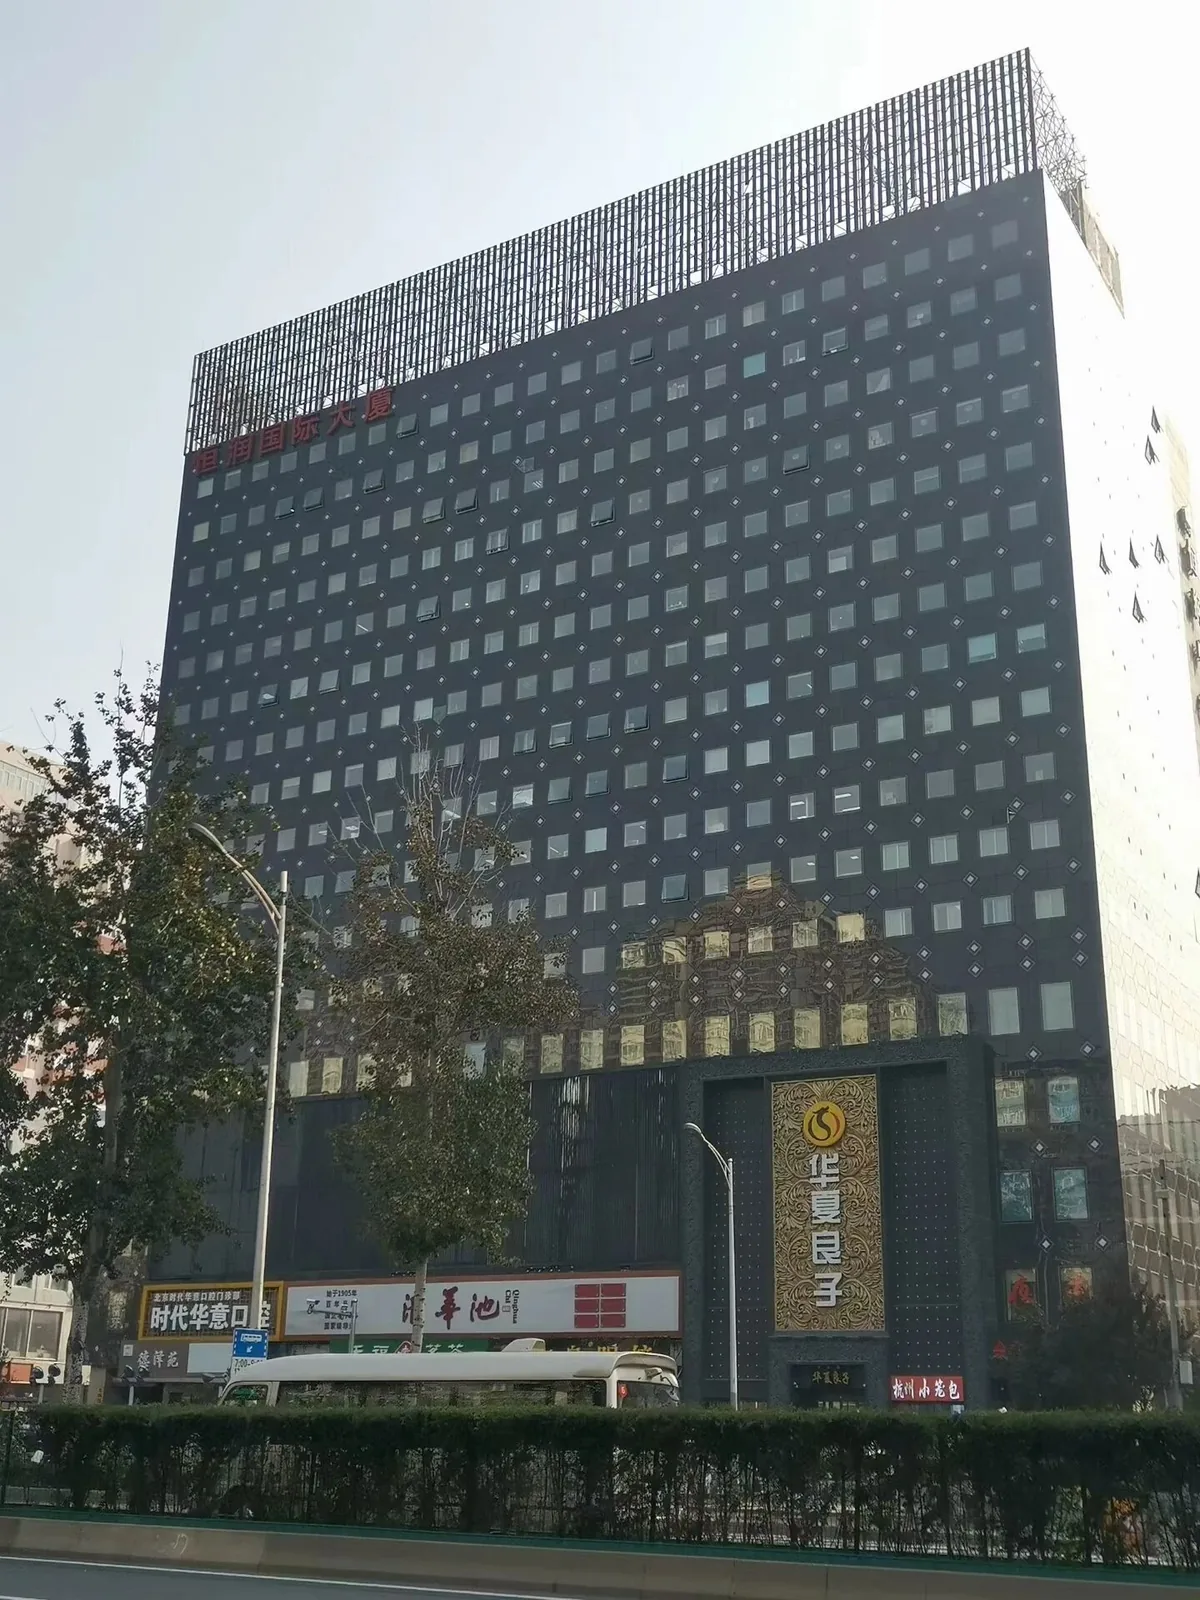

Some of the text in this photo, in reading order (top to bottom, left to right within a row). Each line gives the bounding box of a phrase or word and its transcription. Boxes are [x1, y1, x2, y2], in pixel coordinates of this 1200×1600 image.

[193, 386, 394, 477] 恒润国际大厦
[809, 1153, 843, 1308] 华夏良子
[153, 1291, 241, 1302] 北京时代华意口腔门诊部
[811, 1370, 850, 1385] 华夏良子
[892, 1378, 961, 1400] 杭州小笼包
